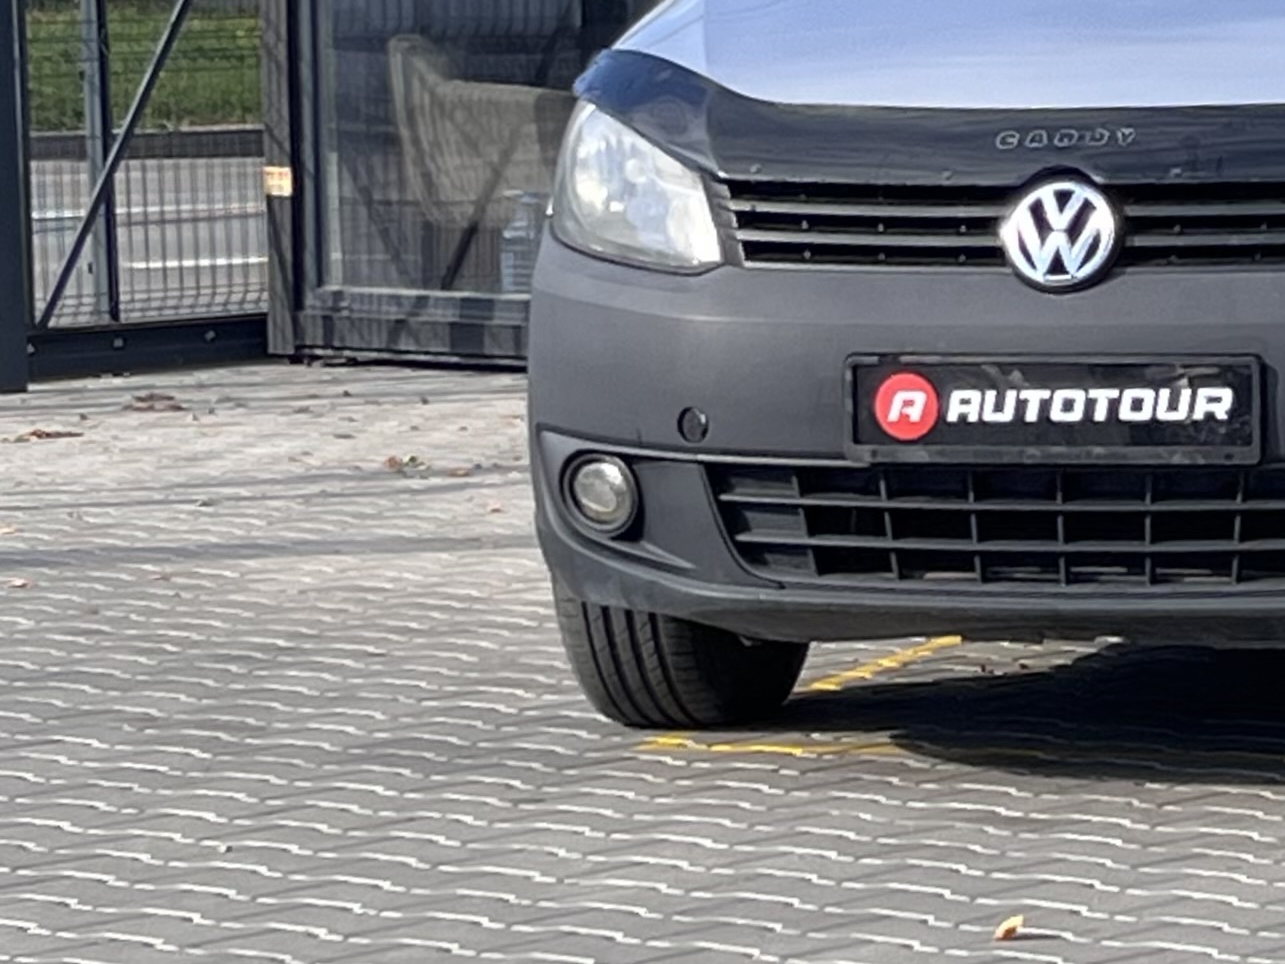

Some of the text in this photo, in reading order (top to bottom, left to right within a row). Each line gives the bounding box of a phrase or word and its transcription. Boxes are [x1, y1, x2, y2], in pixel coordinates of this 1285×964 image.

[1004, 183, 1114, 285] VW
[886, 387, 1234, 423] A AUTOTOUR
